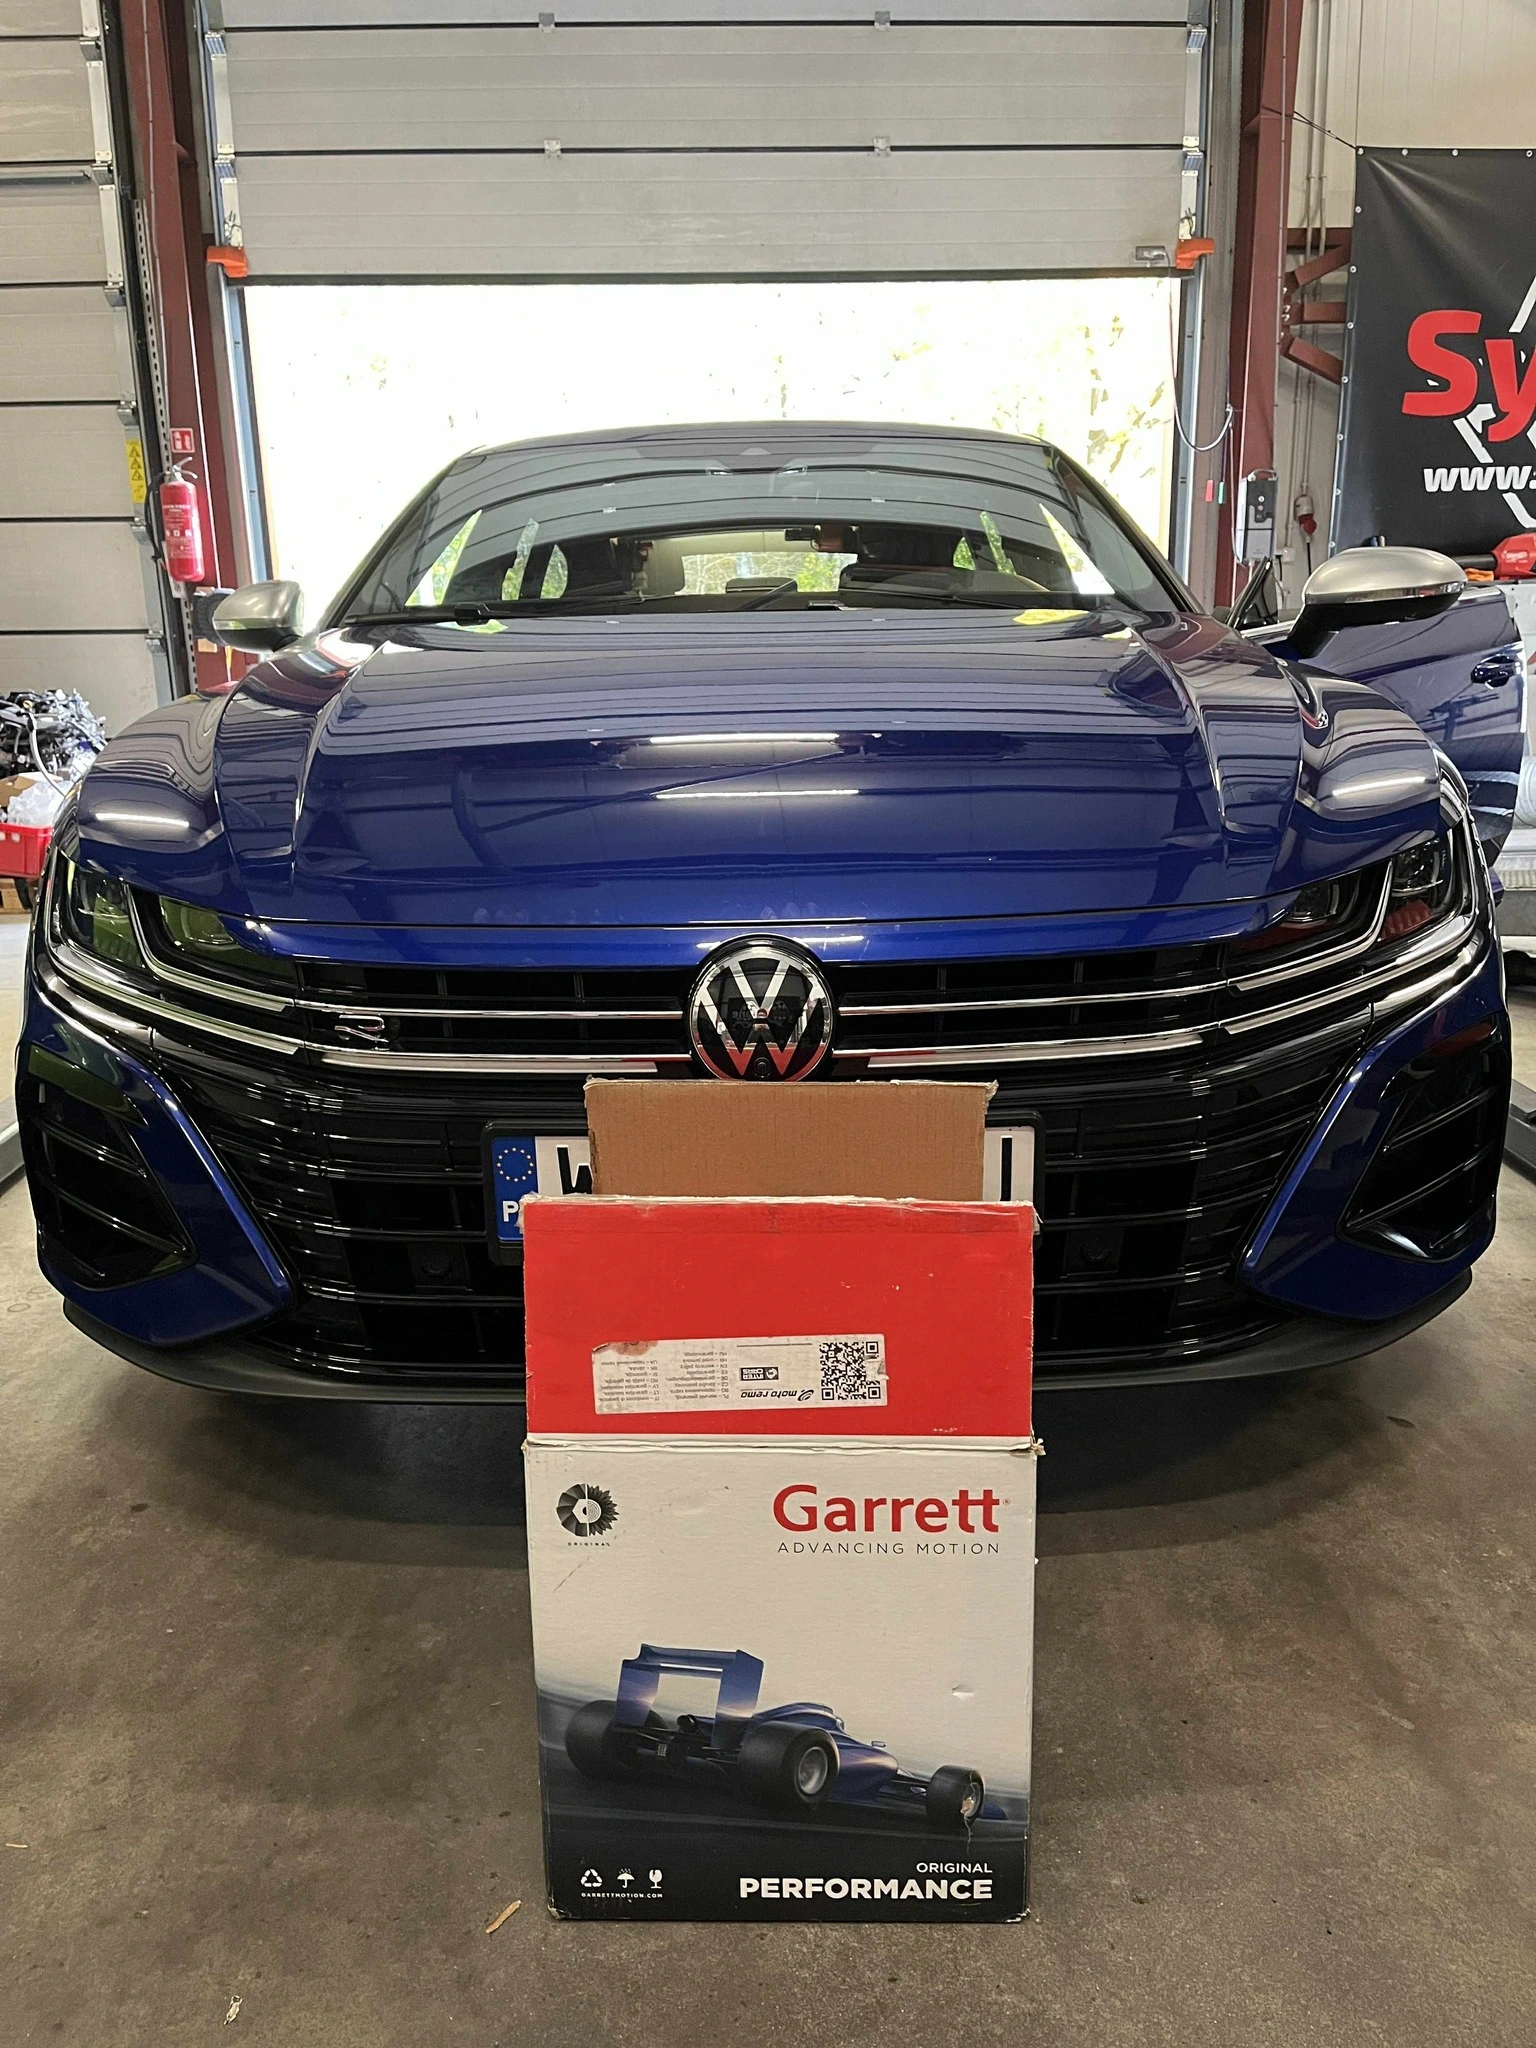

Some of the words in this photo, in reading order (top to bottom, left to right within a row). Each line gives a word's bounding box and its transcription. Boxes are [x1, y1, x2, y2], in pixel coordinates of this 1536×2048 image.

[502, 1201, 519, 1222] P
[770, 1390, 797, 1399] moto
[773, 1484, 1000, 1533] Garrett
[777, 1542, 905, 1555] ADVANCING
[916, 1542, 1000, 1555] MOTION
[916, 1862, 993, 1874] ORIGINAL
[739, 1877, 993, 1900] PERFORMANCE
